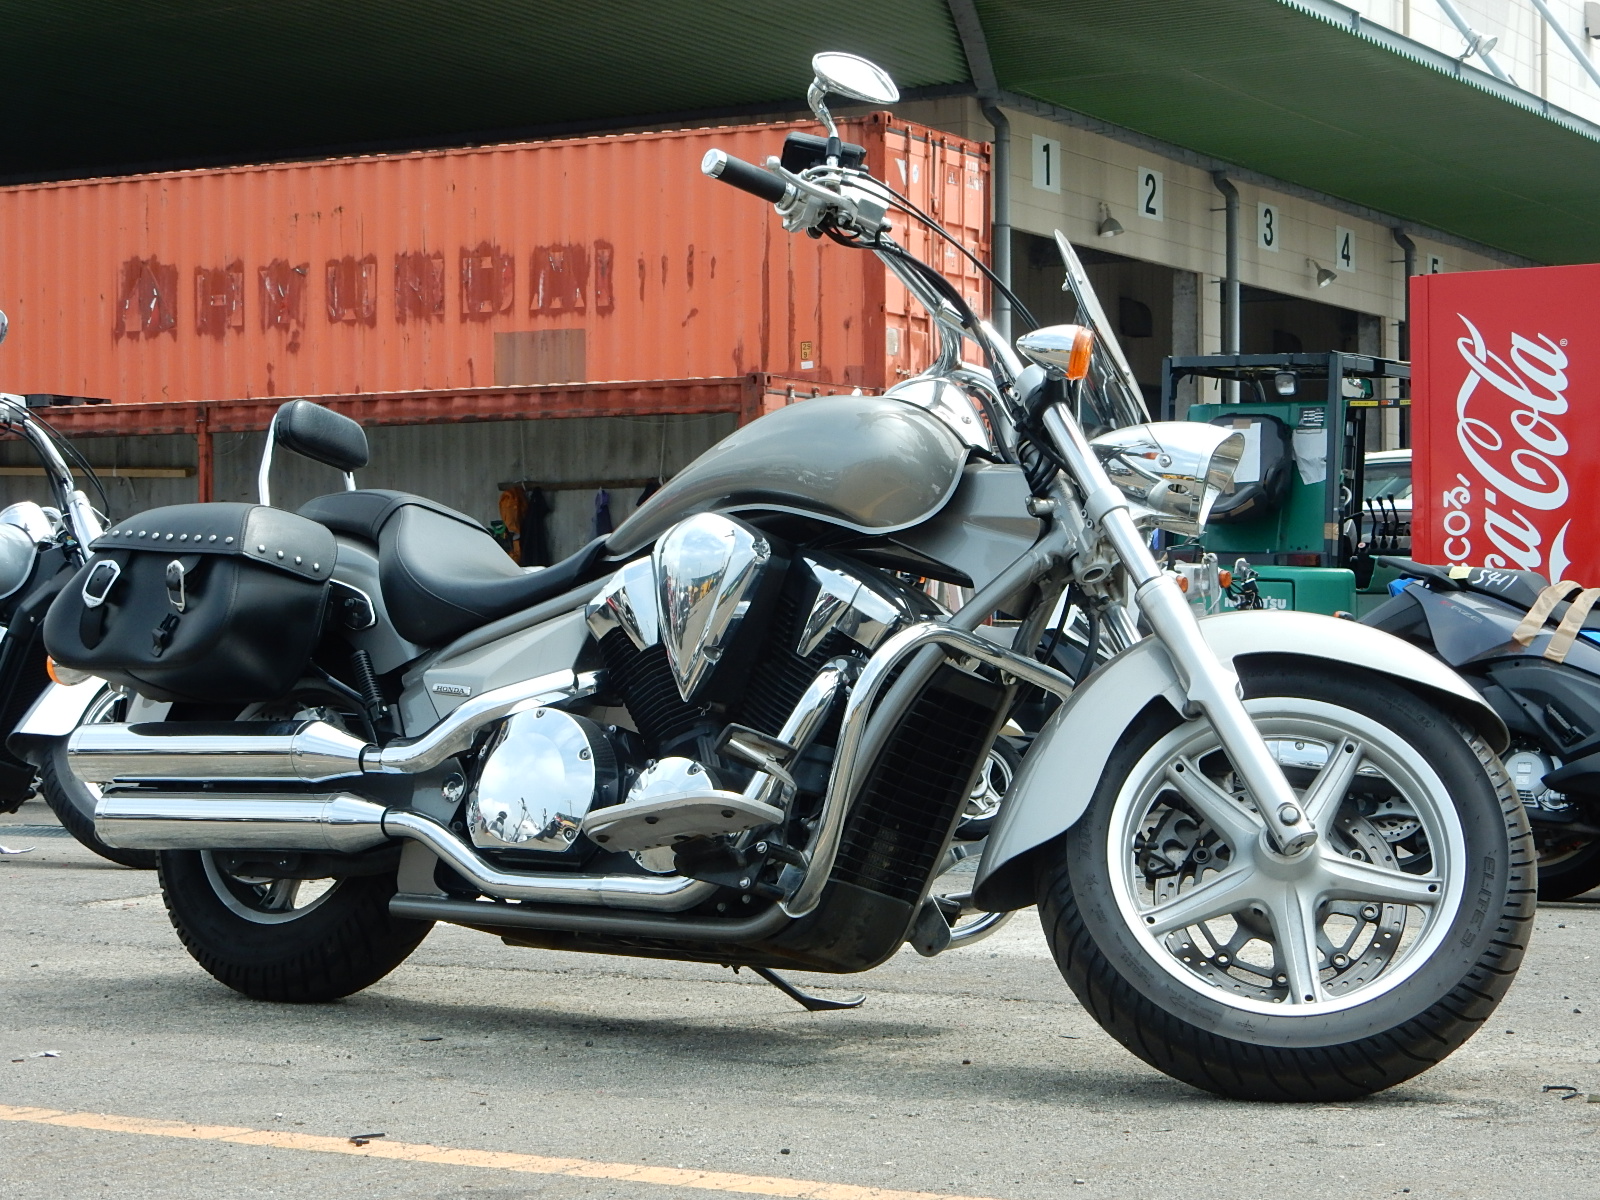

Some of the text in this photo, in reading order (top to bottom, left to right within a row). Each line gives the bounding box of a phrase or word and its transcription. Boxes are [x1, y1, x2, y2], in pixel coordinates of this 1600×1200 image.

[1042, 143, 1051, 186] 1
[1144, 173, 1157, 216] 2
[1263, 207, 1274, 247] 3
[1340, 232, 1351, 268] 4
[436, 685, 465, 694] HONDA
